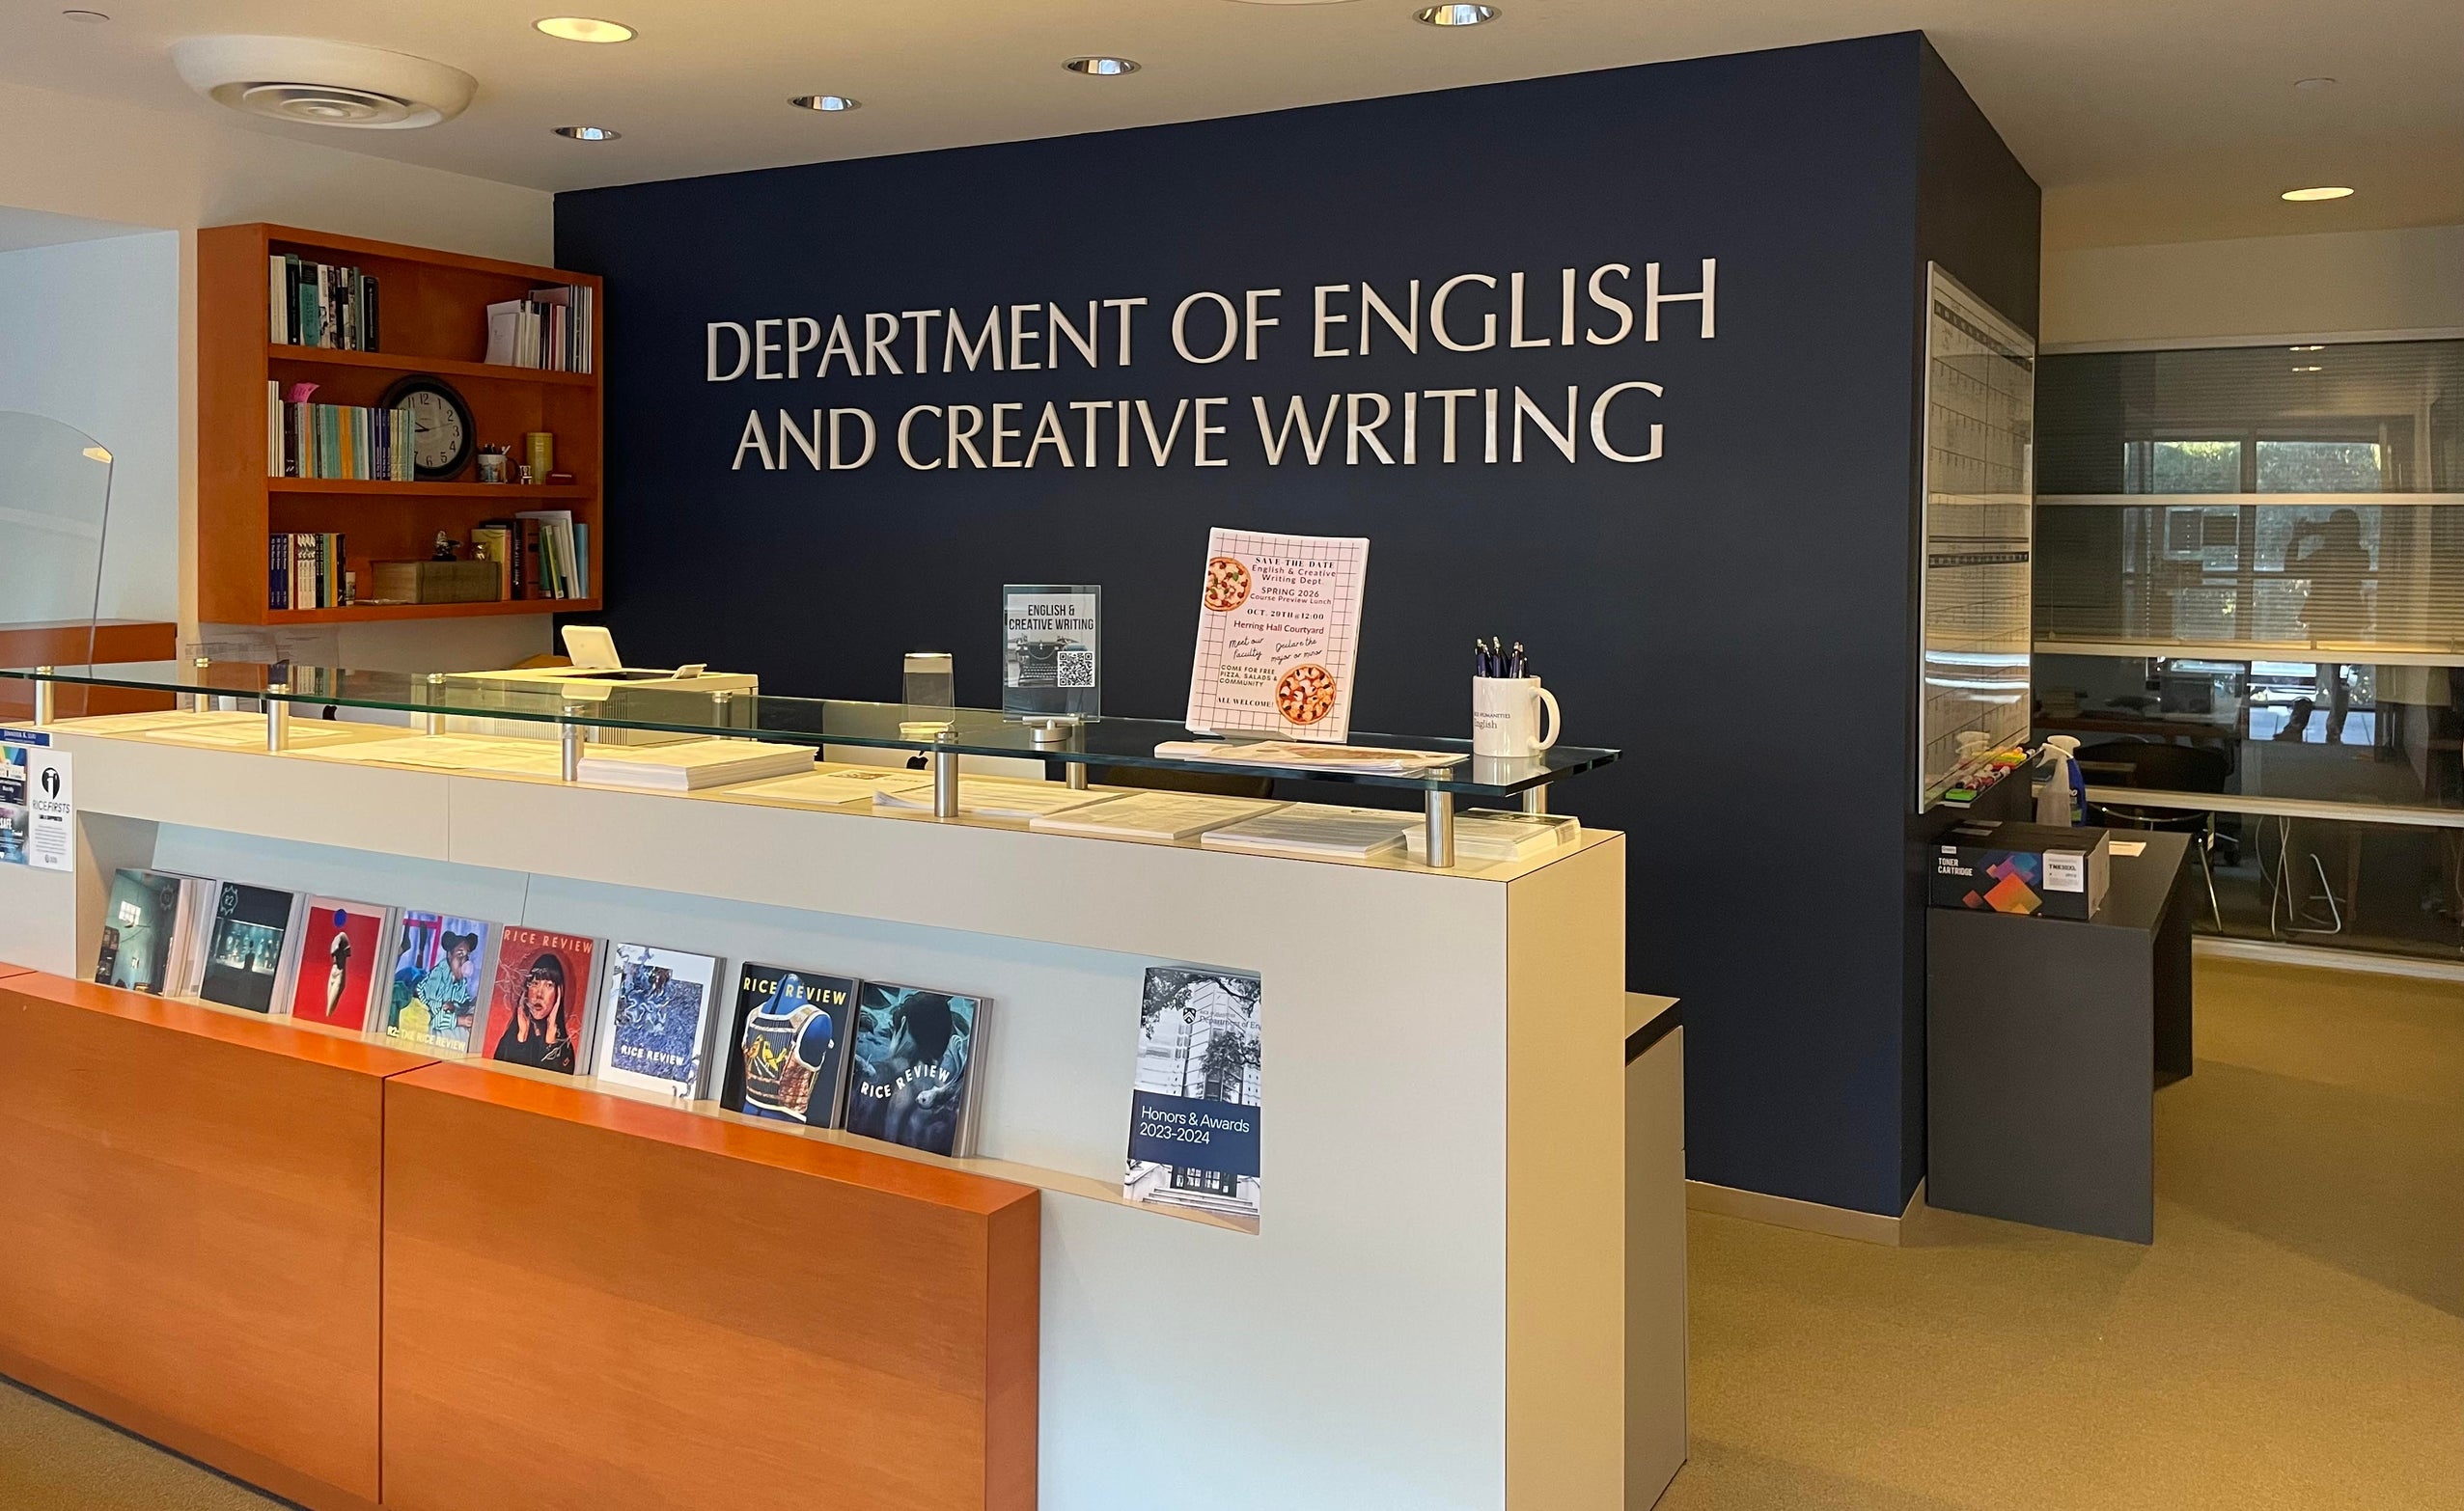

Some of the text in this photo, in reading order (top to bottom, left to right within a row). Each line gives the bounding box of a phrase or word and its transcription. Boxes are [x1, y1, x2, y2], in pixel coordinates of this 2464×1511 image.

[706, 257, 1717, 382] DEPARTMENT OF ENGLISH
[420, 393, 429, 405] 12
[437, 398, 442, 410] 1
[446, 409, 454, 422] 2
[453, 426, 460, 437] 3
[732, 381, 1665, 471] AND CREATIVE WRITING
[449, 440, 457, 453] 4
[426, 454, 433, 466] 6
[440, 452, 448, 463] 5
[1255, 557, 1280, 565] SAVE
[1252, 564, 1285, 574] English
[1297, 568, 1336, 577] Creative
[1261, 573, 1296, 585] Writing
[1250, 592, 1275, 601] Course
[1278, 594, 1308, 603] Preview
[1261, 587, 1319, 598] SPRING 2026
[1028, 604, 1075, 617] ENGLISH &
[1009, 618, 1094, 630] CREATIVE WRITING
[1233, 620, 1324, 635] Herring Hall Courtyard
[1305, 637, 1317, 646] the
[1219, 677, 1264, 687] COMMUNITY
[1938, 858, 1959, 866] TONER
[1937, 865, 1974, 877] CARTRIDGE
[503, 929, 593, 953] RICE REVIEW
[743, 976, 847, 1005] RICE REVIEW
[401, 1029, 415, 1041] THE
[416, 1032, 435, 1044] RICE
[435, 1036, 466, 1052] REVIEW
[621, 1044, 684, 1066] RICE REVIEW
[860, 1064, 951, 1099] RICE REVIEW
[1141, 1105, 1250, 1133] Honors & Awards
[1140, 1122, 1210, 1145] 2023-2024
